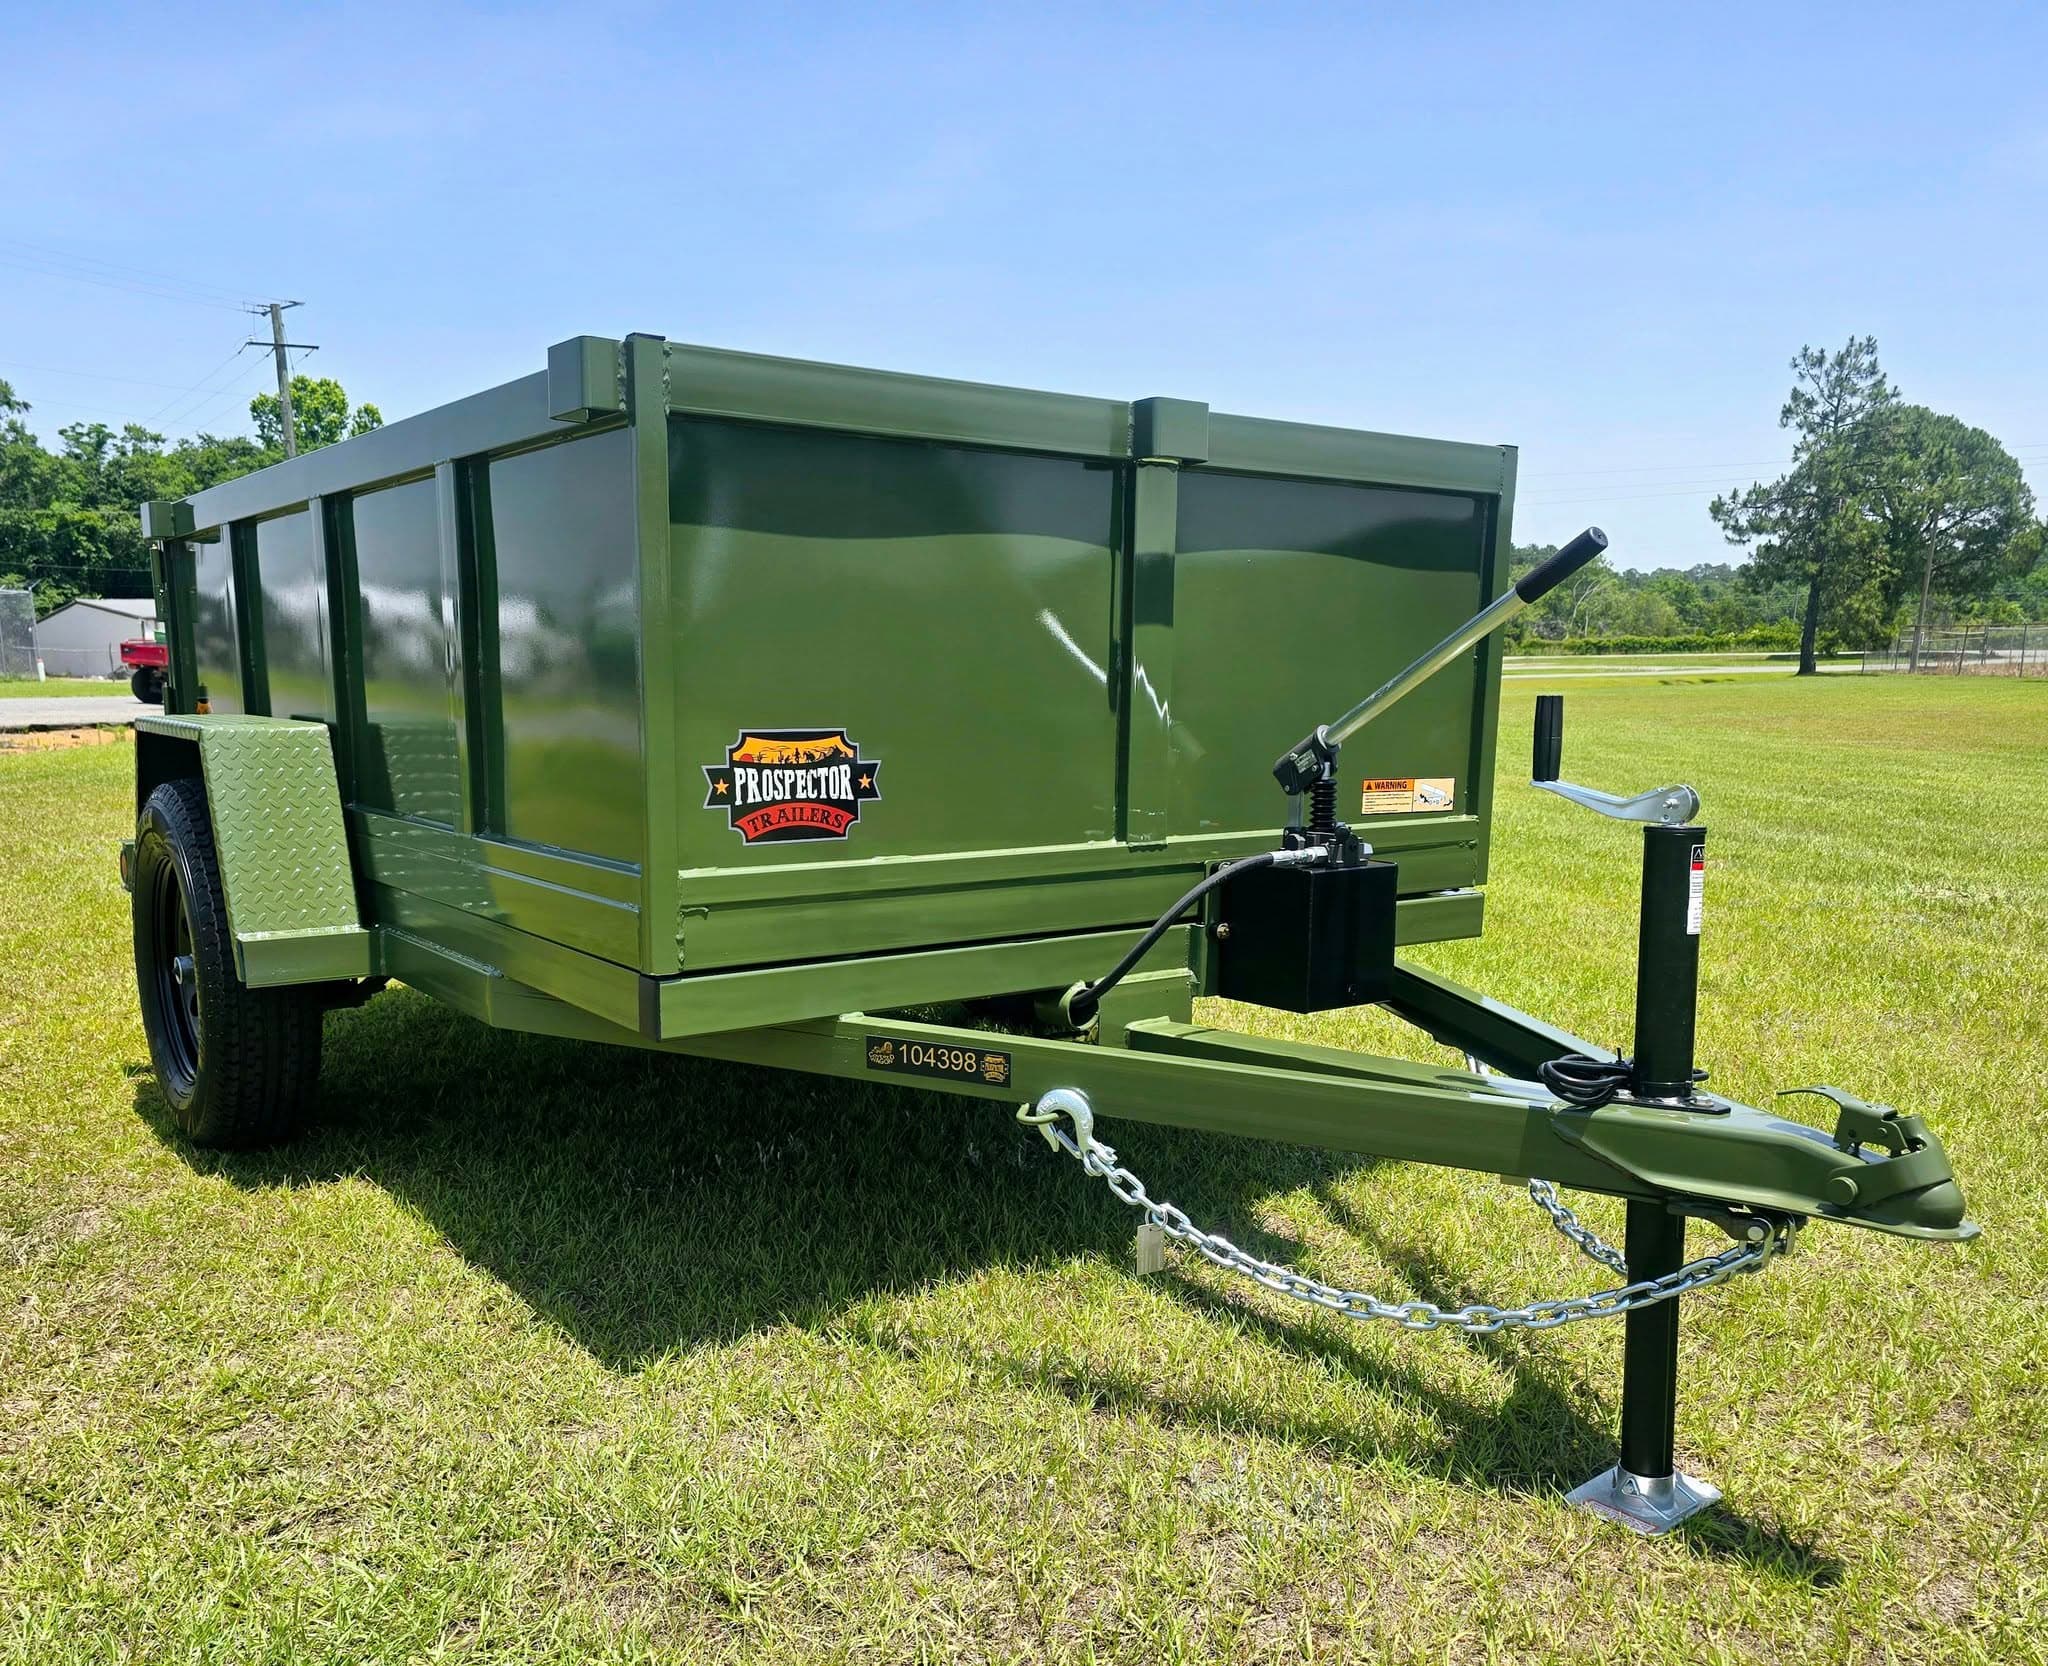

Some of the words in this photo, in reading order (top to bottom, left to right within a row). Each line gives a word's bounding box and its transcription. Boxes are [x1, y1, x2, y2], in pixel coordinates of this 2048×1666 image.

[733, 764, 855, 806] PROSPECTOR
[1374, 781, 1407, 790] WARNING
[747, 807, 844, 833] TRAILERS
[899, 1043, 977, 1073] 104398
